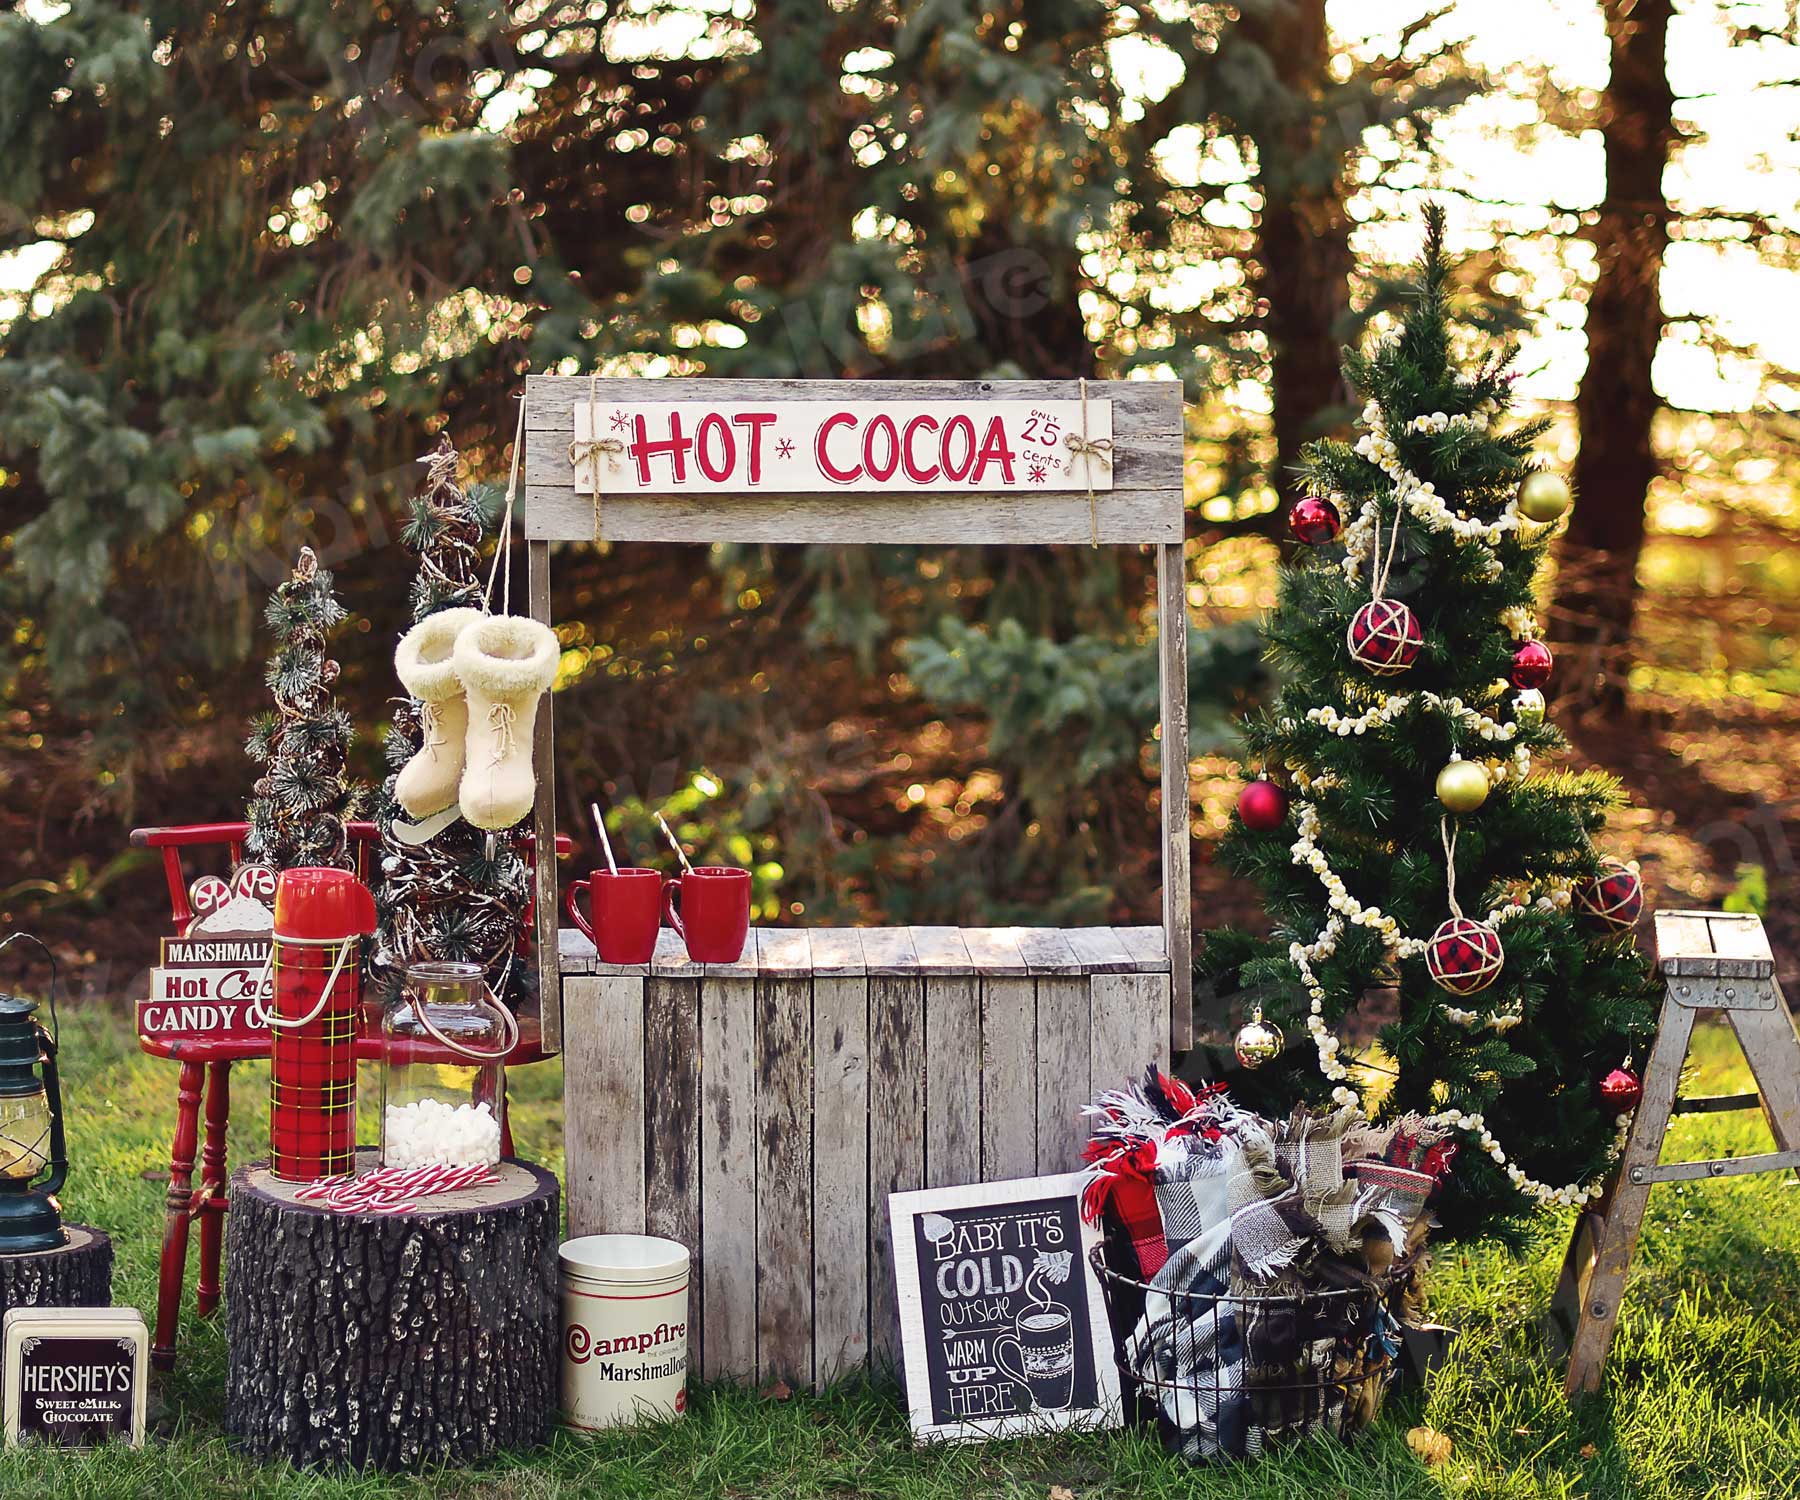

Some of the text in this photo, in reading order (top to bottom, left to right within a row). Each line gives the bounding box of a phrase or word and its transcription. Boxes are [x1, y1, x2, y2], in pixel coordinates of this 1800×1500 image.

[1030, 409, 1059, 422] ONLY
[1021, 418, 1060, 446] 25
[628, 411, 1016, 486] HOT COCOA
[166, 976, 209, 999] Hot
[144, 1005, 237, 1032] CANDY
[934, 1215, 1064, 1262] BABY IT'S
[936, 1254, 1024, 1299] COLD
[566, 1322, 686, 1364] Campfire
[943, 1338, 988, 1368] WARM
[24, 1362, 131, 1392] HERSHEY'S
[946, 1366, 997, 1384] UP
[948, 1382, 1017, 1417] HERE
